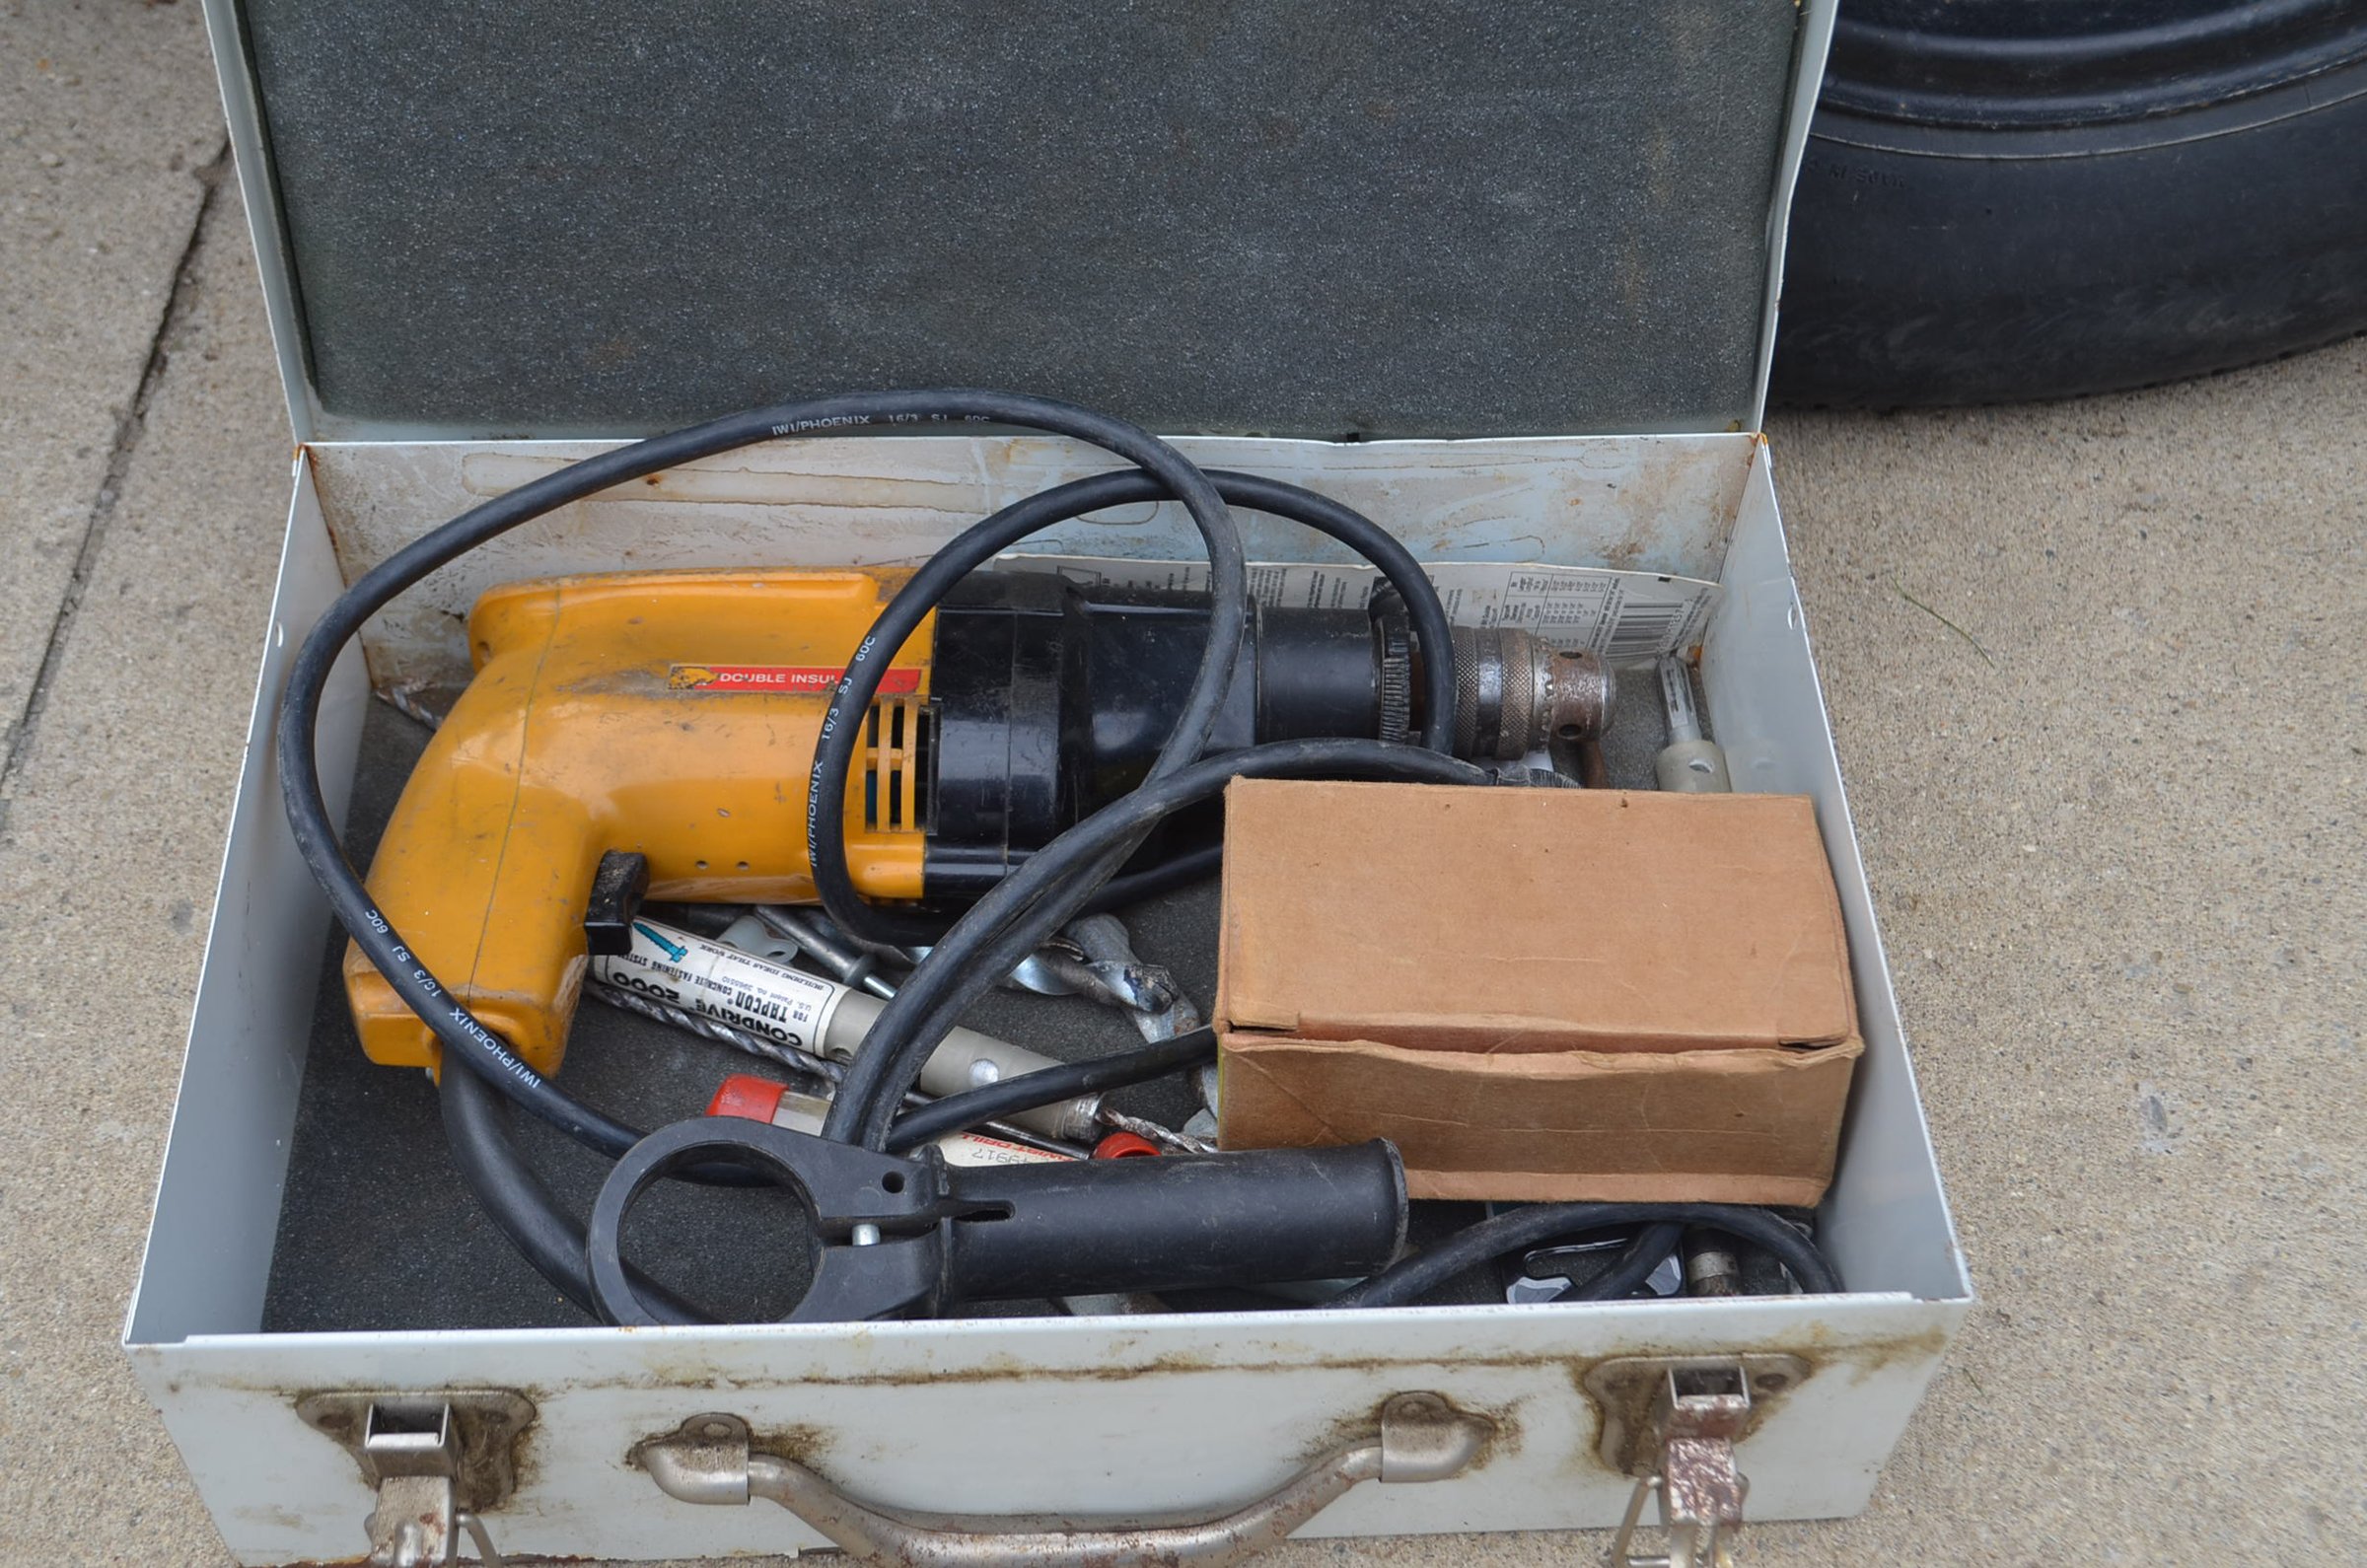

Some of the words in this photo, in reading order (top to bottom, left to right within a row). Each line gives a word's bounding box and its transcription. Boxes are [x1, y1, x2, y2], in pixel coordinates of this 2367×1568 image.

[772, 414, 870, 436] IWI/PHOENIX
[719, 673, 785, 683] DOUBLE
[791, 674, 839, 684] INSUL
[821, 708, 840, 740] 16/3
[837, 677, 853, 694] SJ
[855, 636, 876, 662] 60C
[651, 961, 692, 981] FASTENING
[753, 962, 780, 976] IDEAS
[612, 972, 680, 1004] 2000
[693, 976, 732, 996] CONCRETE
[782, 971, 824, 991] BUILDING
[365, 909, 388, 935] 60C
[393, 945, 411, 962] SJ
[413, 969, 443, 998] 16/3
[450, 1007, 541, 1088] IWI/PHOENIX
[769, 991, 794, 1006] Patent
[792, 1009, 809, 1022] FOR
